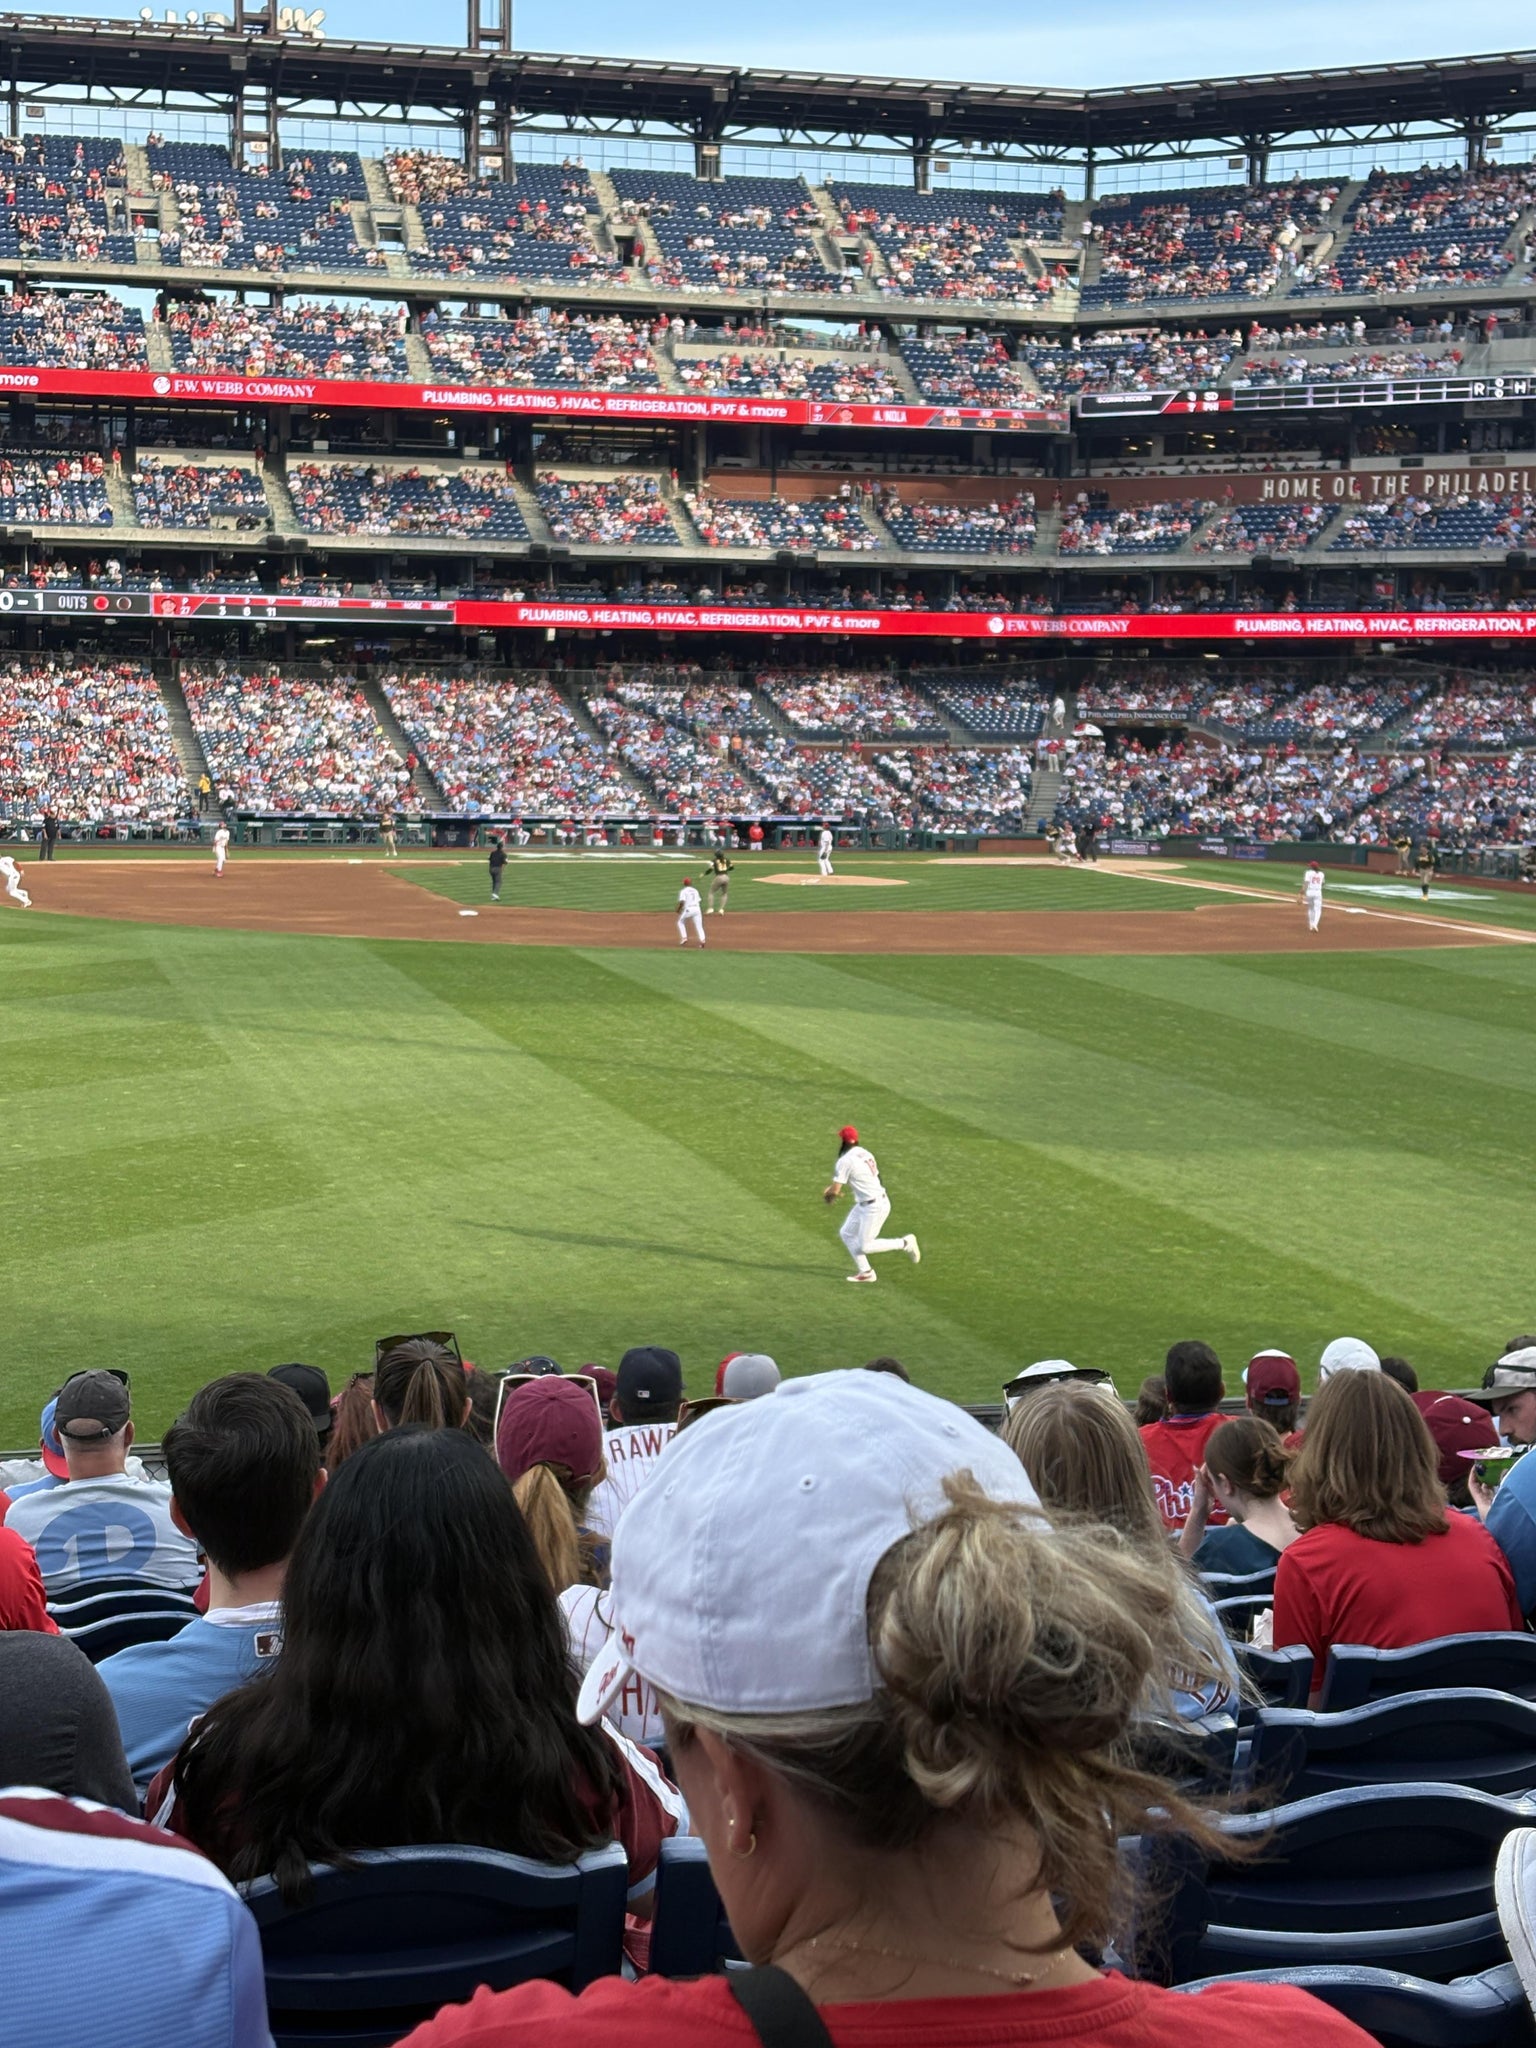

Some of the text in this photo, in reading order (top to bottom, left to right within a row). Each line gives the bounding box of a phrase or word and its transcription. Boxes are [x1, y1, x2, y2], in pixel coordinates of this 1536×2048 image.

[0, 375, 39, 387] more
[1515, 380, 1526, 395] H
[202, 381, 243, 395] WEBB
[245, 383, 316, 398] COMPANY
[1474, 382, 1485, 396] R
[423, 390, 788, 418] PLUMBING, HEATING, HVAC, REFRIGERATION, PVF & more
[1263, 477, 1321, 498] HOME
[1372, 474, 1411, 495] THE
[58, 596, 88, 610] OUTS
[519, 608, 880, 630] PLUMBING, HEATING, HVAC, REFRIGERATION, PVF & more
[1030, 620, 1067, 632] WEBB
[1069, 620, 1130, 633] COMPANY
[1236, 618, 1304, 633] PLUMBING,
[1307, 618, 1367, 633] HEATING,
[1369, 618, 1412, 633] HVAC,
[1415, 618, 1523, 633] REFRIGERATION,
